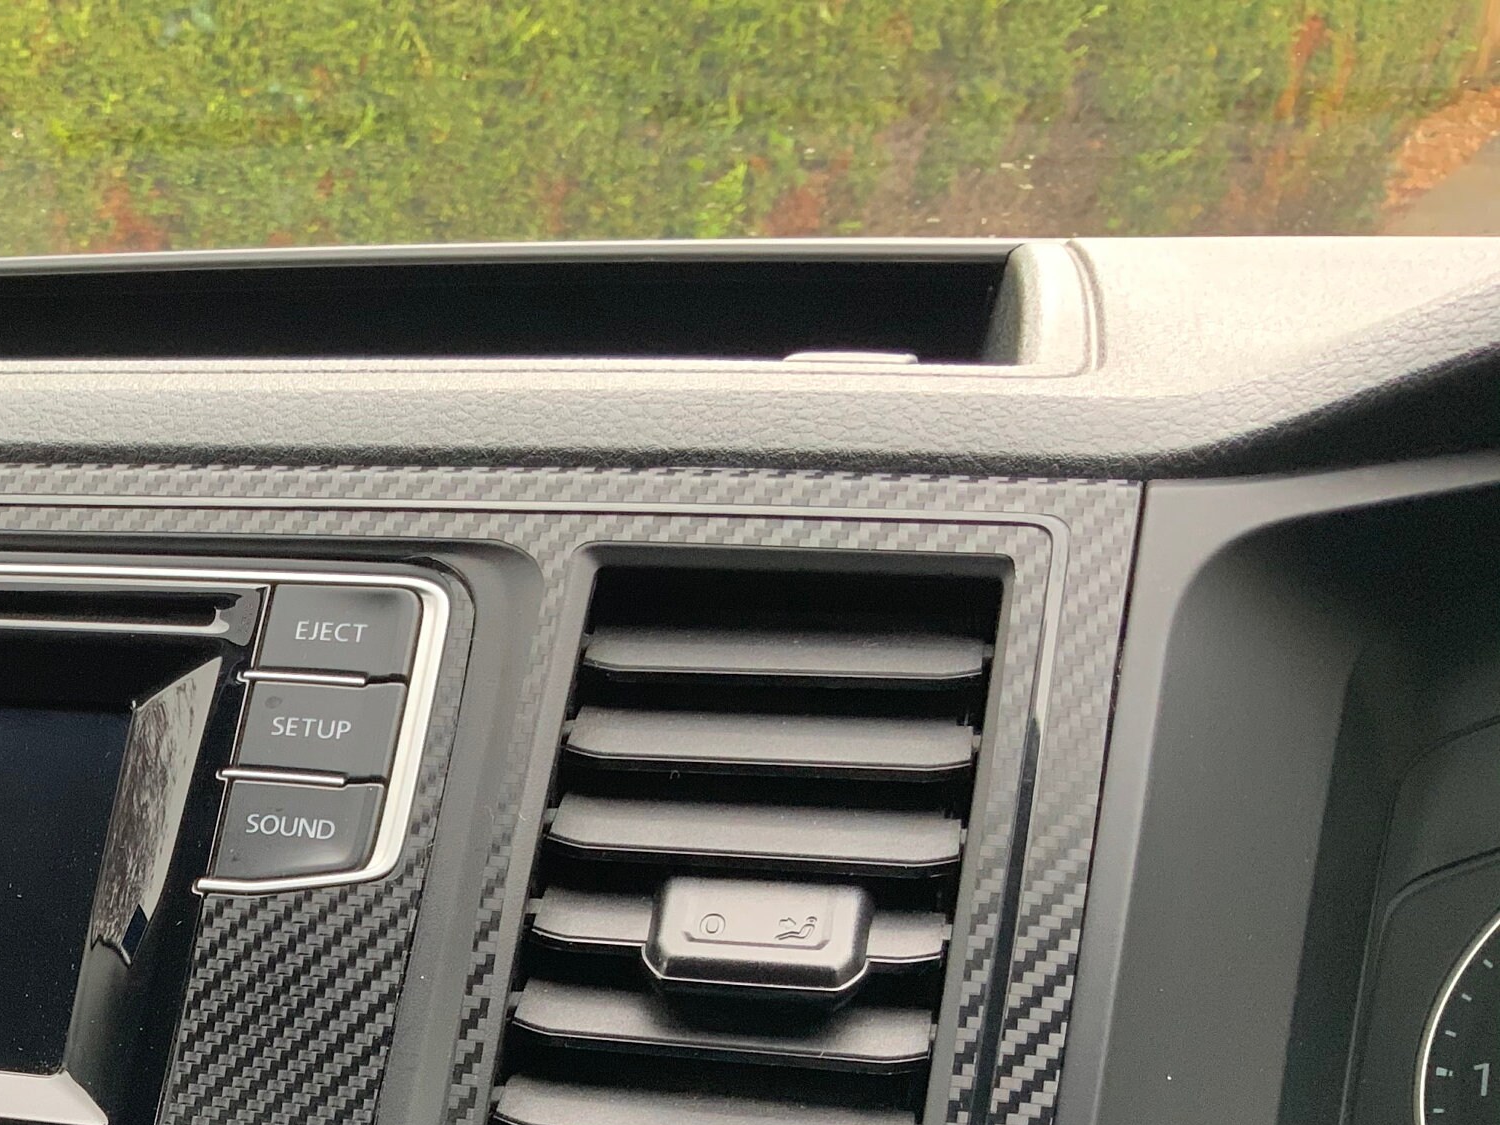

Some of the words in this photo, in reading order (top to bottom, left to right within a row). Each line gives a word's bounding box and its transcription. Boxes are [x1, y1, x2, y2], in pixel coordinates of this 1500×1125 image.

[294, 620, 368, 643] EJECT
[271, 716, 352, 740] SETUP
[245, 813, 336, 840] SOUND
[1473, 1062, 1490, 1097] 1
